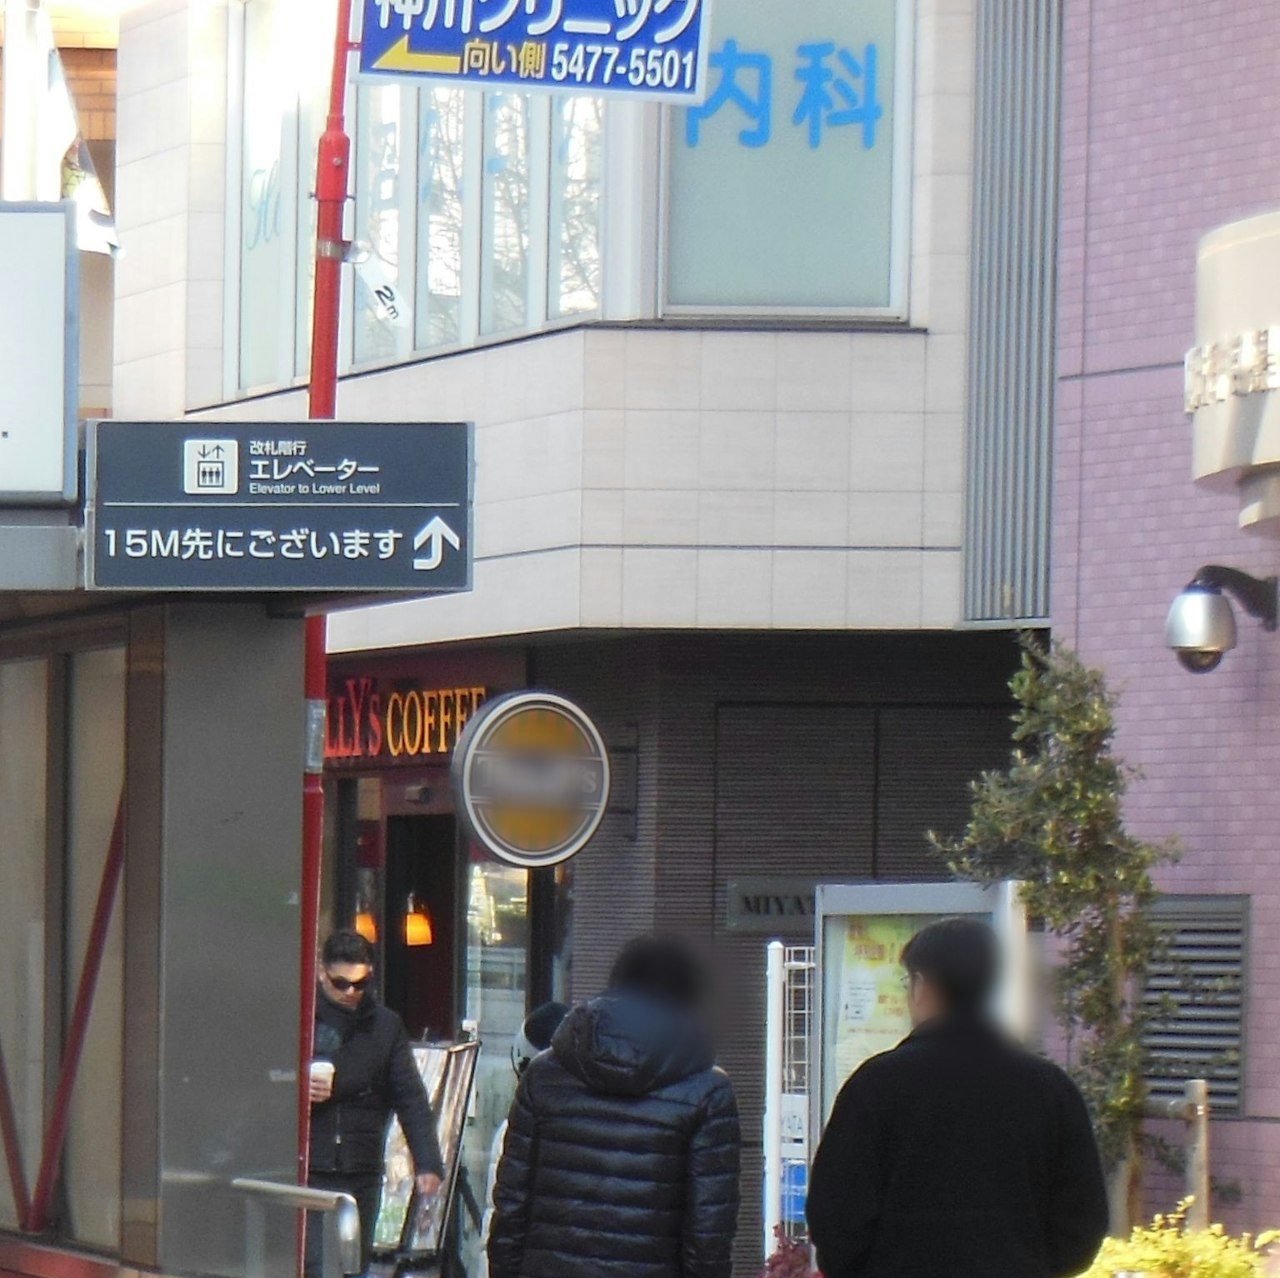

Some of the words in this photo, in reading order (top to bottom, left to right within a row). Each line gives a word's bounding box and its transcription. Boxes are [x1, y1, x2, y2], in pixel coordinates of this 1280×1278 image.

[463, 38, 546, 79] 向い側
[551, 42, 694, 89] 5477-5501
[686, 38, 883, 149] 内科
[249, 440, 307, 456] 改札階行
[249, 458, 380, 481] エレベーター
[249, 482, 295, 495] Elevator
[298, 483, 310, 495] to
[312, 482, 347, 495] Lower
[349, 483, 381, 495] Level
[104, 527, 404, 560] 15M先にございます
[386, 686, 487, 757] COFFE
